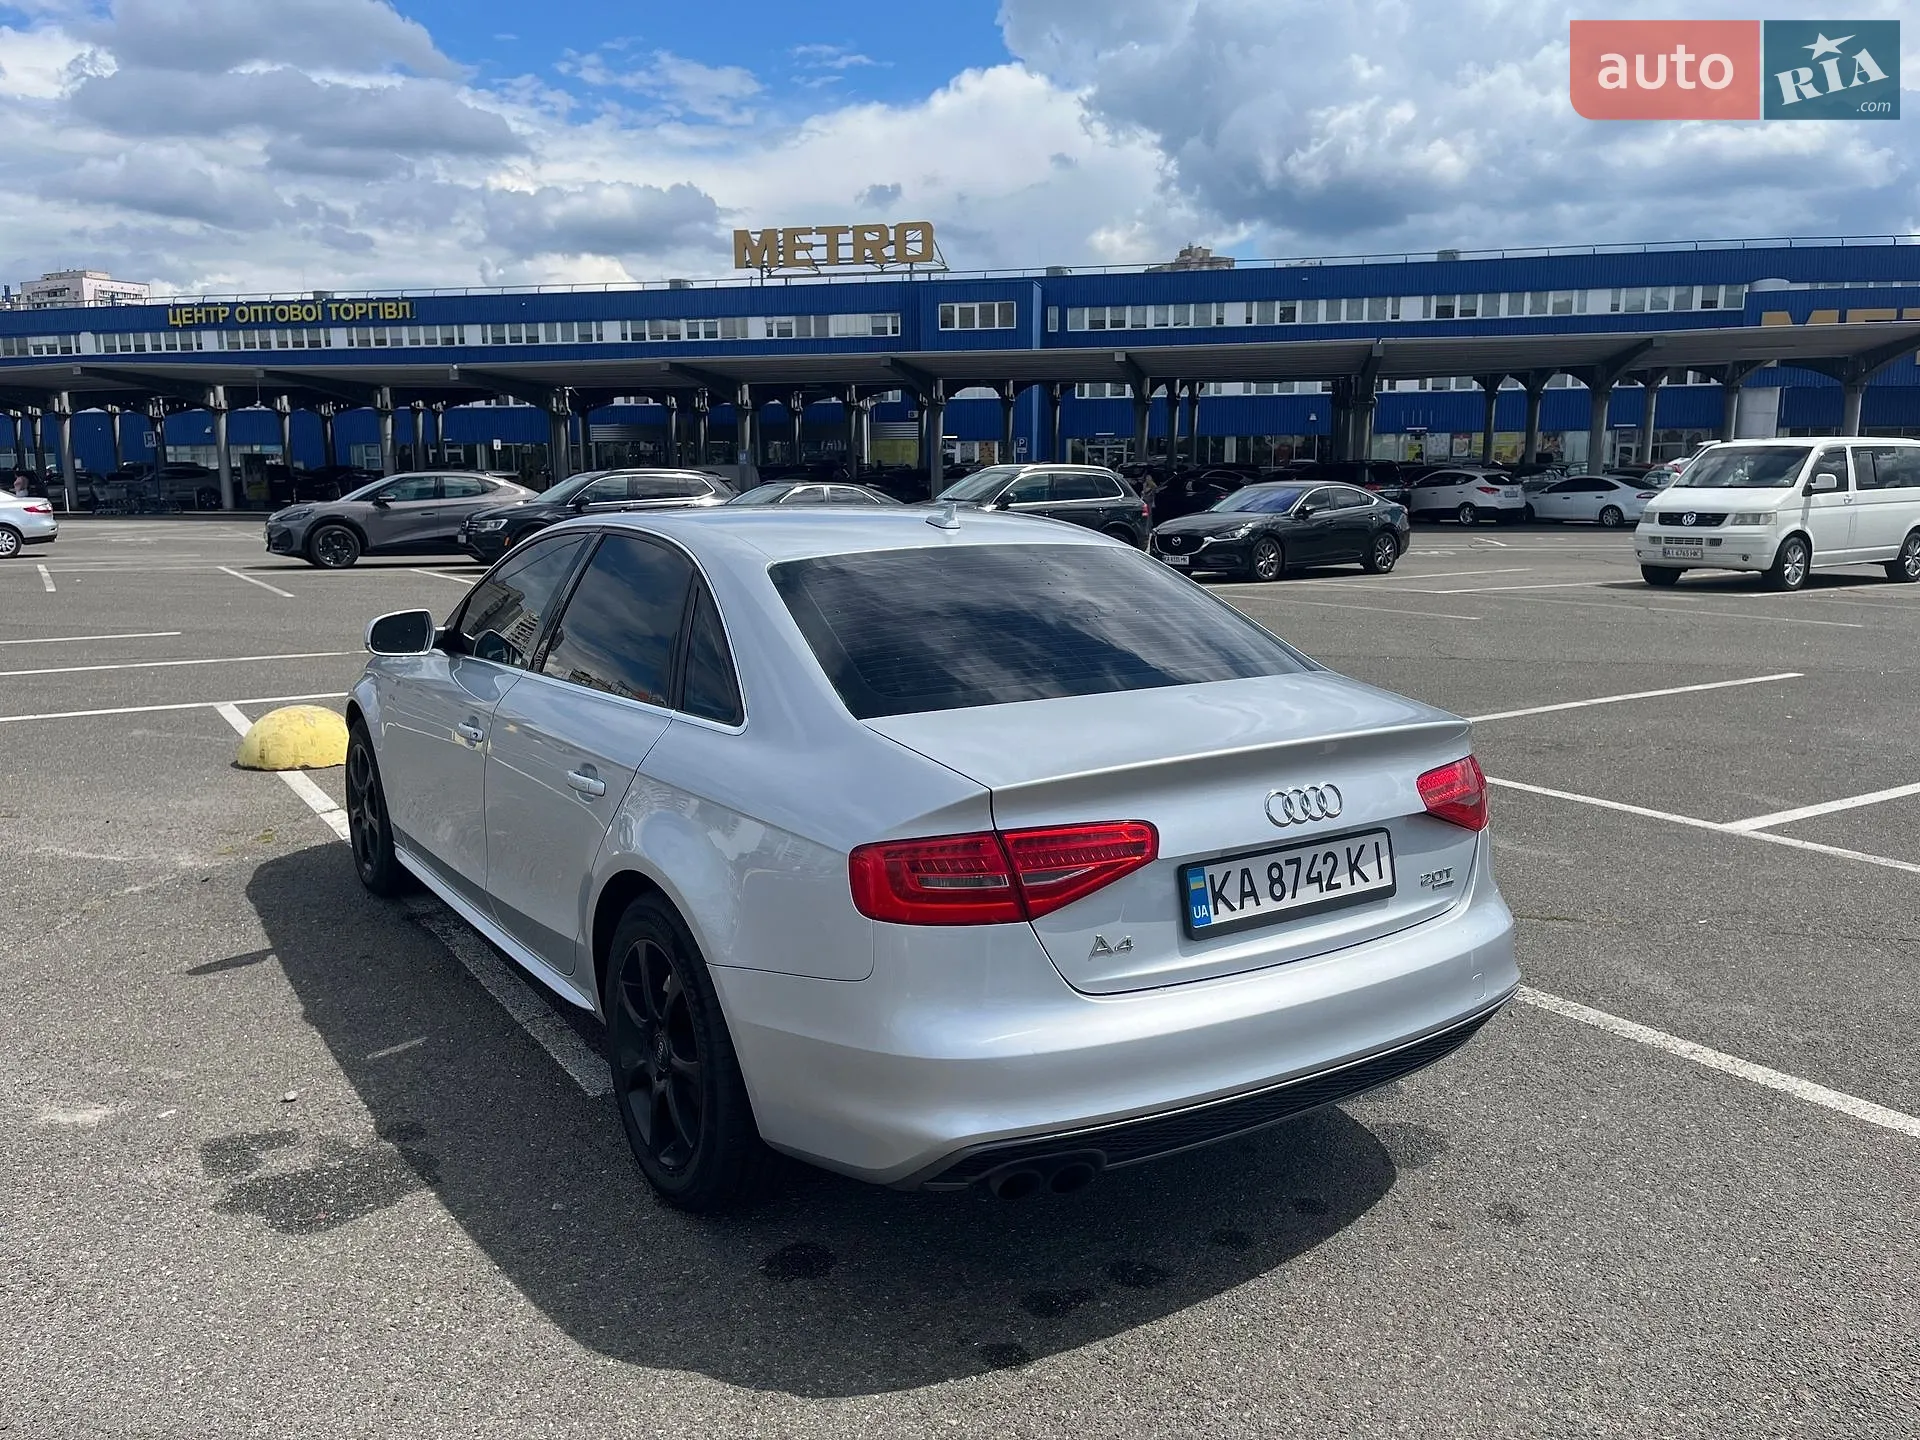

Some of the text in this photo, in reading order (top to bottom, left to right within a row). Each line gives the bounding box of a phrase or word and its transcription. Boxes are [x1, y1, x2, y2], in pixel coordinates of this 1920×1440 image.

[733, 221, 934, 269] METRO
[168, 307, 230, 328] ЦЕНТР
[235, 300, 322, 323] ОПТОВОЇ
[1209, 841, 1384, 915] KA 8742 KI
[1193, 905, 1209, 919] UA
[1088, 934, 1134, 961] A4
